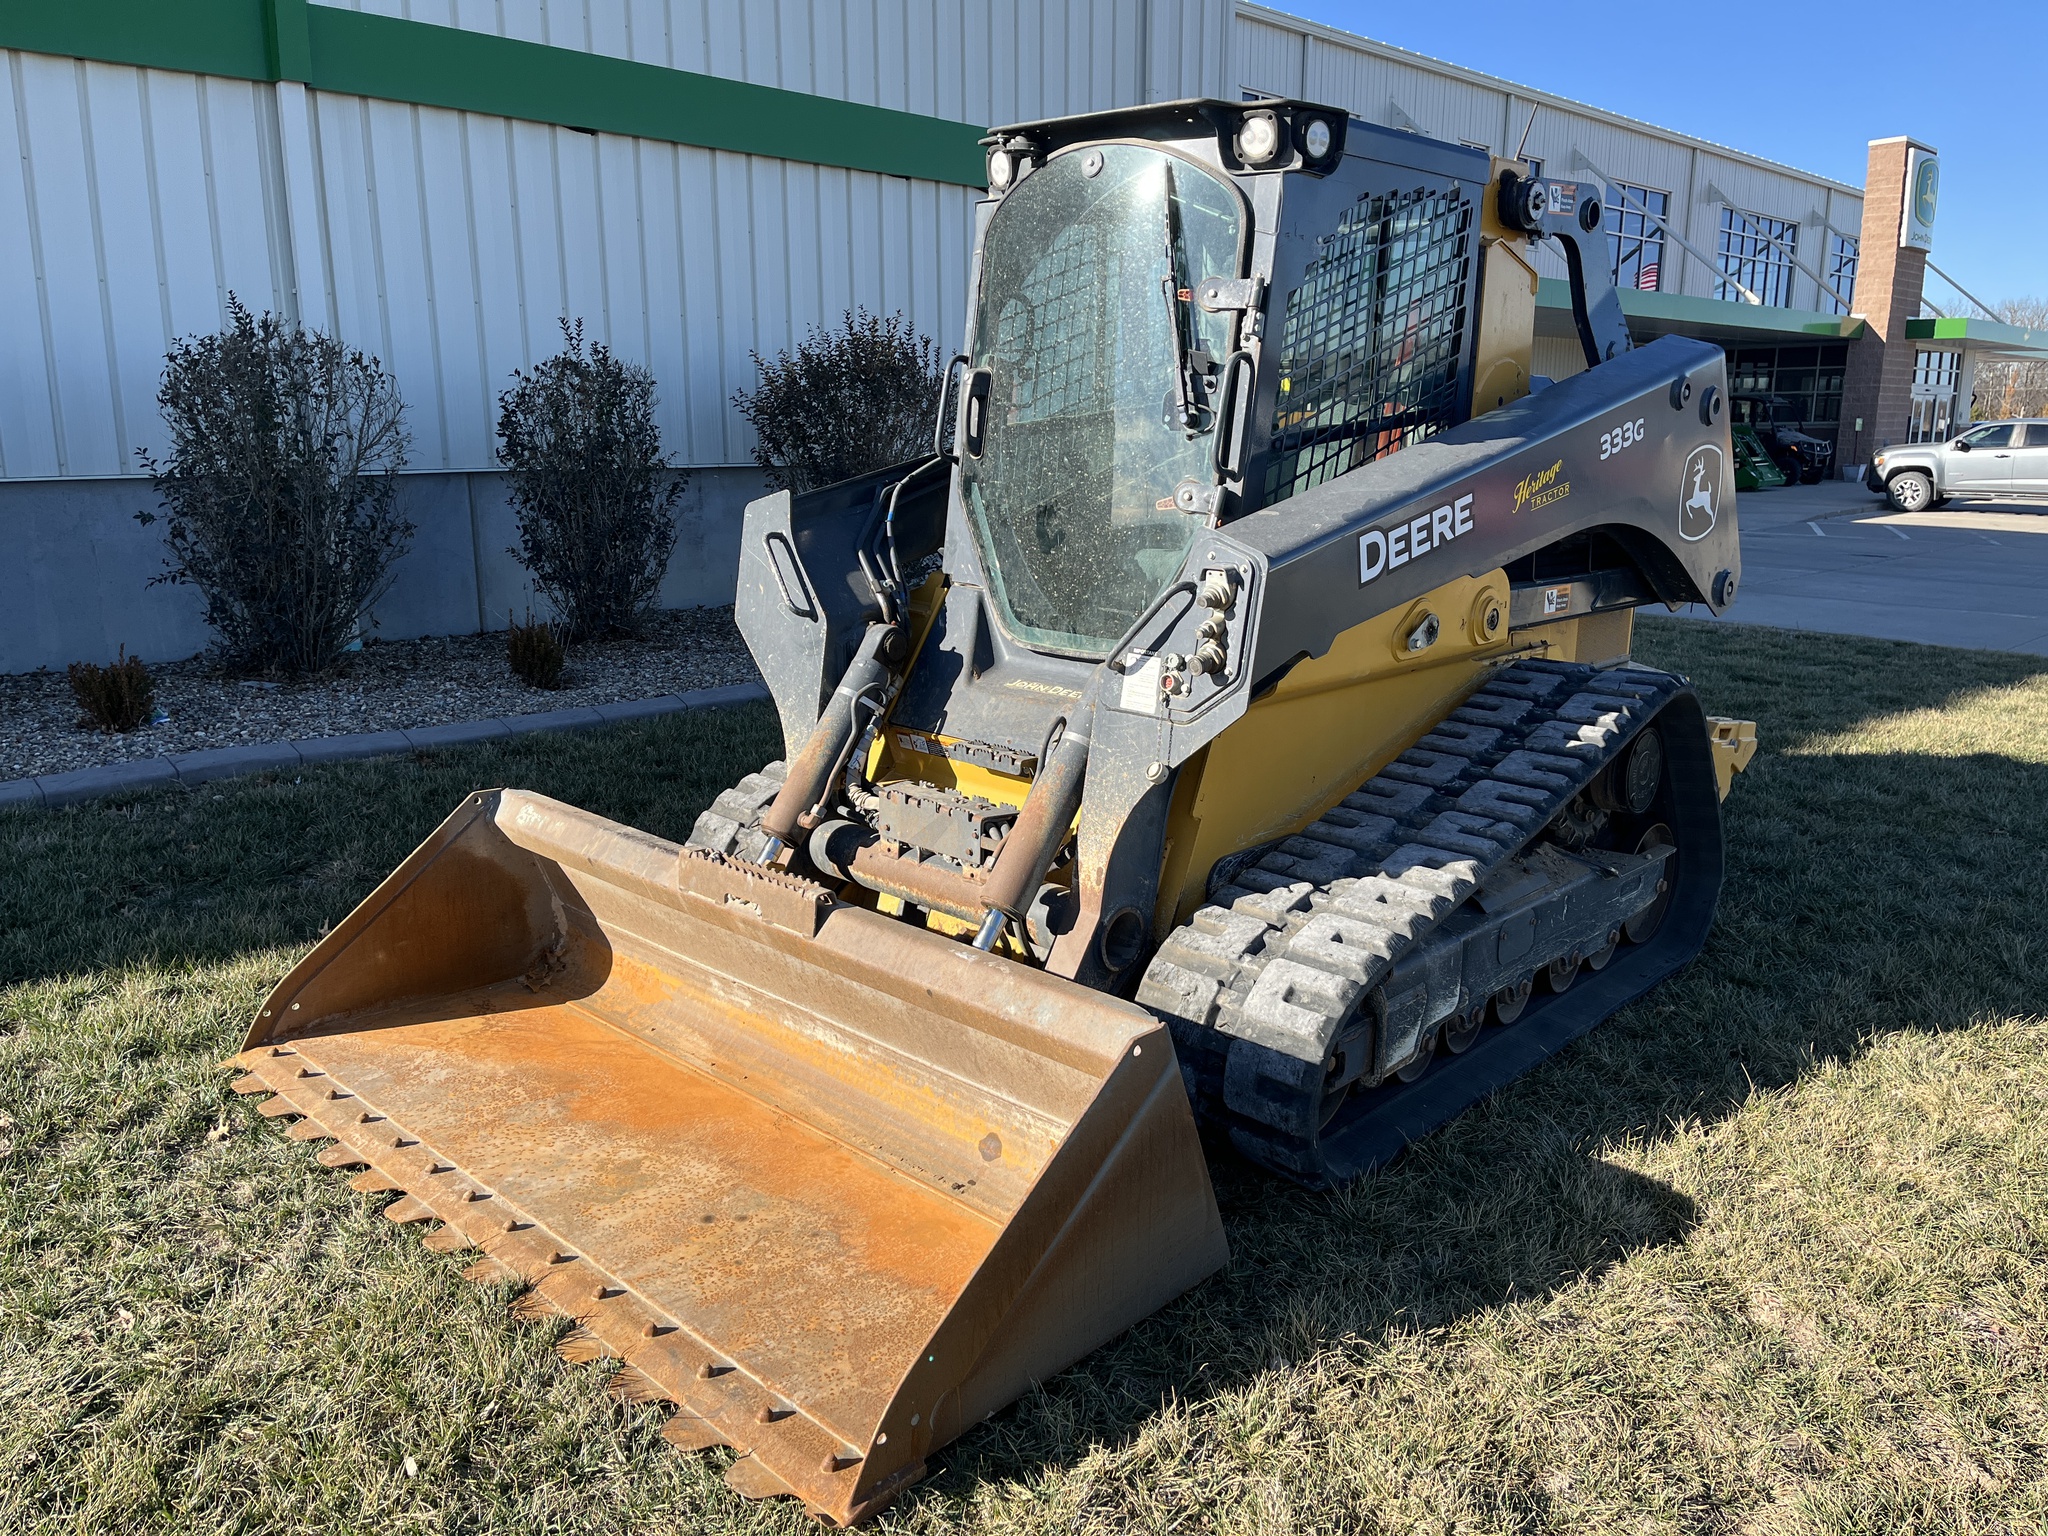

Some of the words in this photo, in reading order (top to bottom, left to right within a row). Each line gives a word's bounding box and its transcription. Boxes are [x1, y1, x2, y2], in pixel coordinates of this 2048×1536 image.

[1600, 418, 1644, 461] 333G
[1512, 459, 1563, 514] Heritage
[1531, 484, 1570, 509] TRACTOR
[1360, 493, 1473, 584] DEERE
[1004, 679, 1049, 692] JOHN
